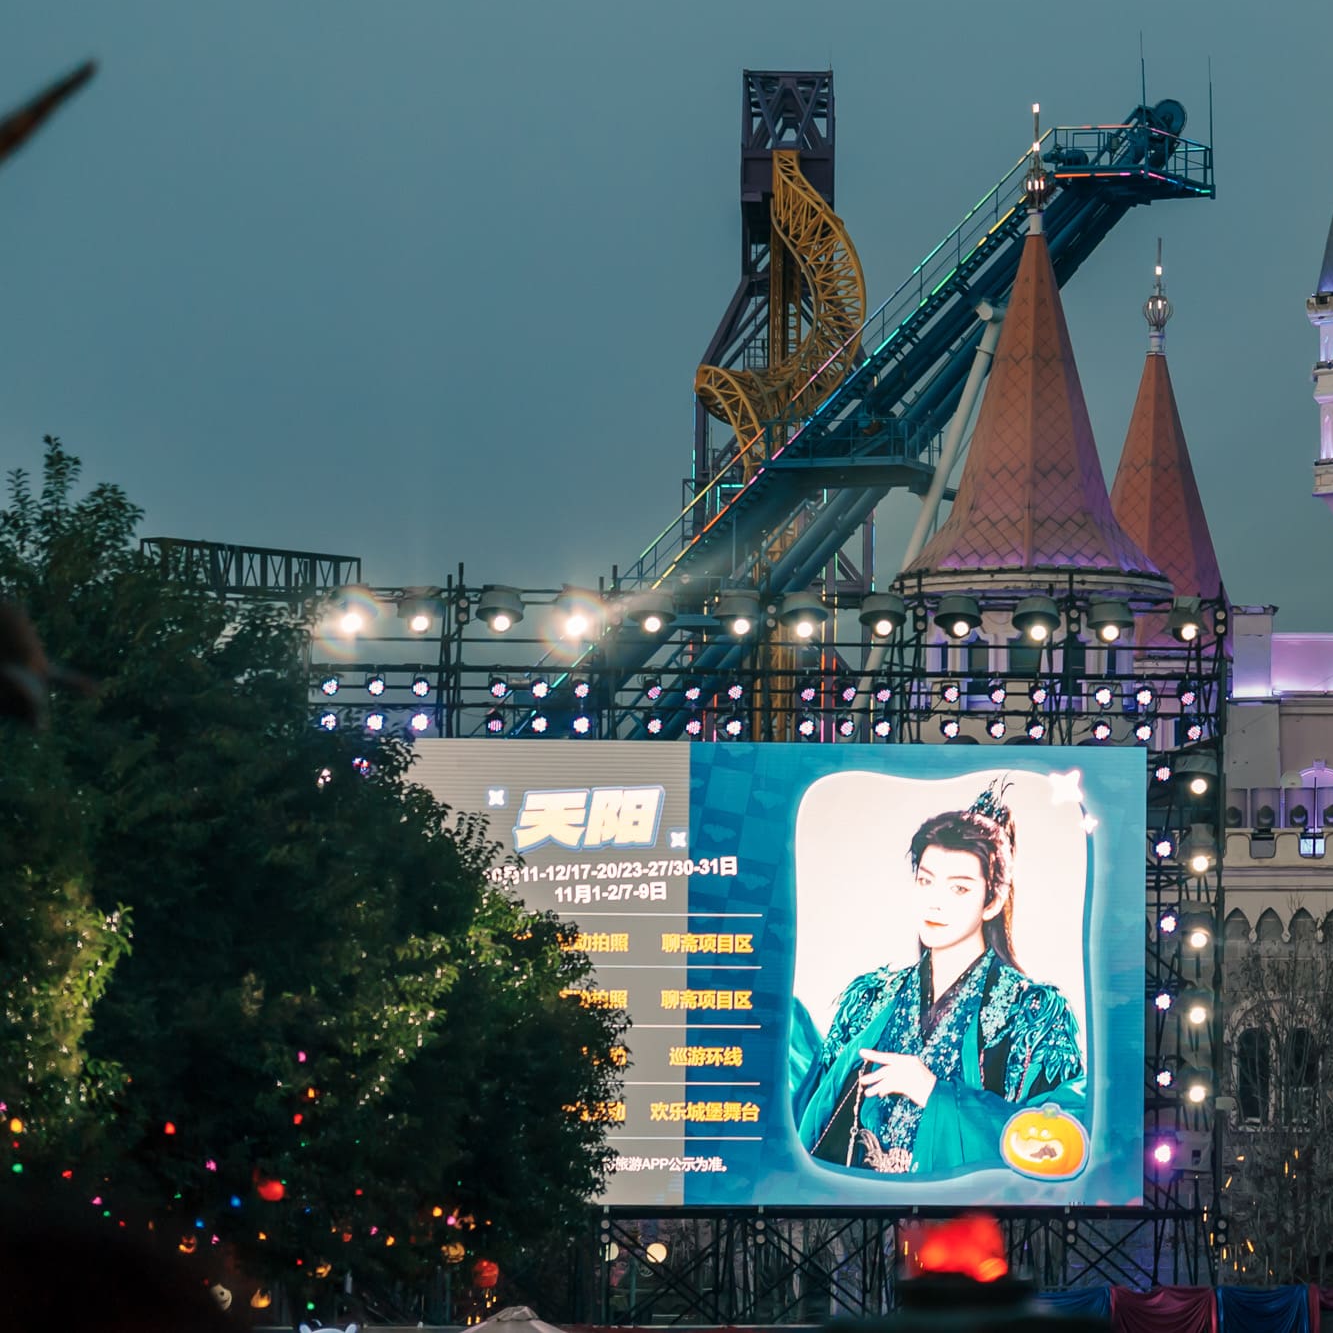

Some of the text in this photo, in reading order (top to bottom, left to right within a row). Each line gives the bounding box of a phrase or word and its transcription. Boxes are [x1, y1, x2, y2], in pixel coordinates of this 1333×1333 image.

[512, 785, 665, 854] 天阳
[554, 881, 667, 904] 11月1-2/7-9日
[661, 933, 754, 953] 聊斋项目区
[660, 989, 753, 1009] 聊斋项目区
[669, 1046, 743, 1066] 巡游环线
[650, 1102, 760, 1122] 欢乐城堡舞台
